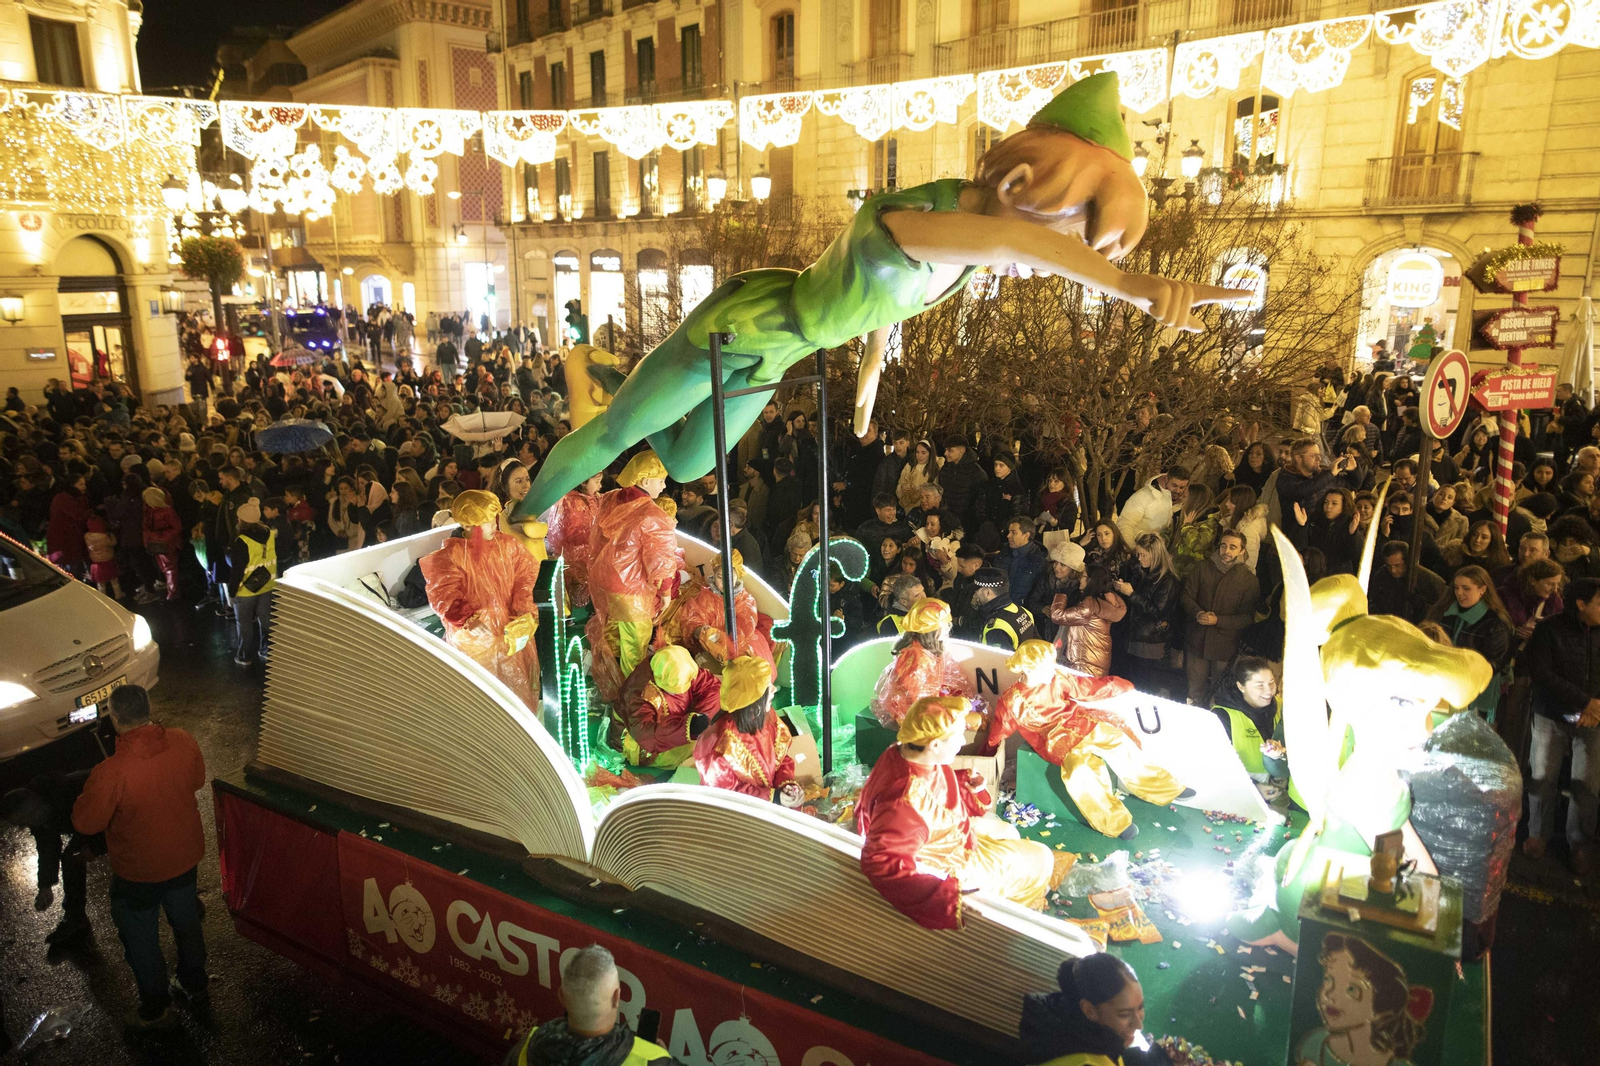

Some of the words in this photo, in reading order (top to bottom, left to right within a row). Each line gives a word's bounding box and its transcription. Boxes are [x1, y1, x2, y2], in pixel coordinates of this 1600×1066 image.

[1392, 281, 1431, 294] KING
[1501, 317, 1525, 329] BOSQUE
[1498, 331, 1527, 341] AVENTURA
[1500, 379, 1521, 390] PISTA
[1522, 378, 1532, 389] DE
[1532, 377, 1552, 389] HIELO
[1509, 392, 1525, 400] Paseo
[975, 667, 999, 695] N
[85, 687, 108, 706] 6513
[1135, 705, 1161, 735] U
[449, 955, 471, 973] 1982
[478, 968, 503, 987] 2022
